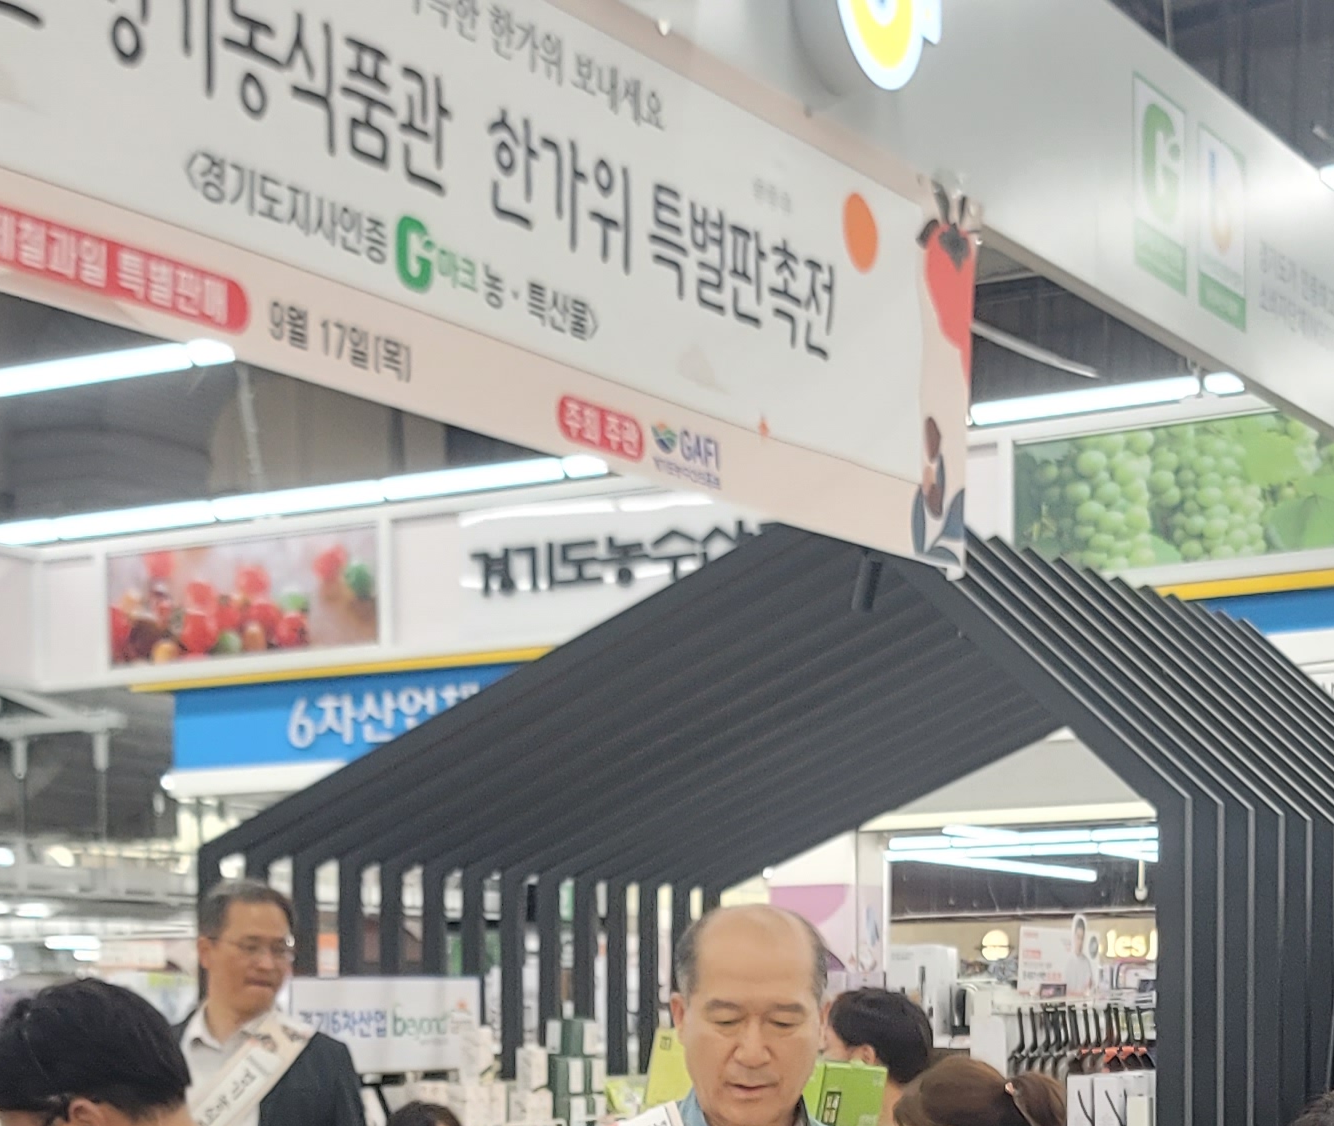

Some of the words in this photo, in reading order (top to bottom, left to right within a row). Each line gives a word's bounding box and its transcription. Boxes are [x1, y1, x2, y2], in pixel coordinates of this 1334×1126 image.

[488, 5, 565, 87] 한가위
[573, 54, 666, 131] 보내세요
[487, 106, 633, 276] 한가위
[647, 181, 836, 361] 특별판촉전
[269, 299, 311, 352] 9월
[679, 427, 721, 472] GAFI
